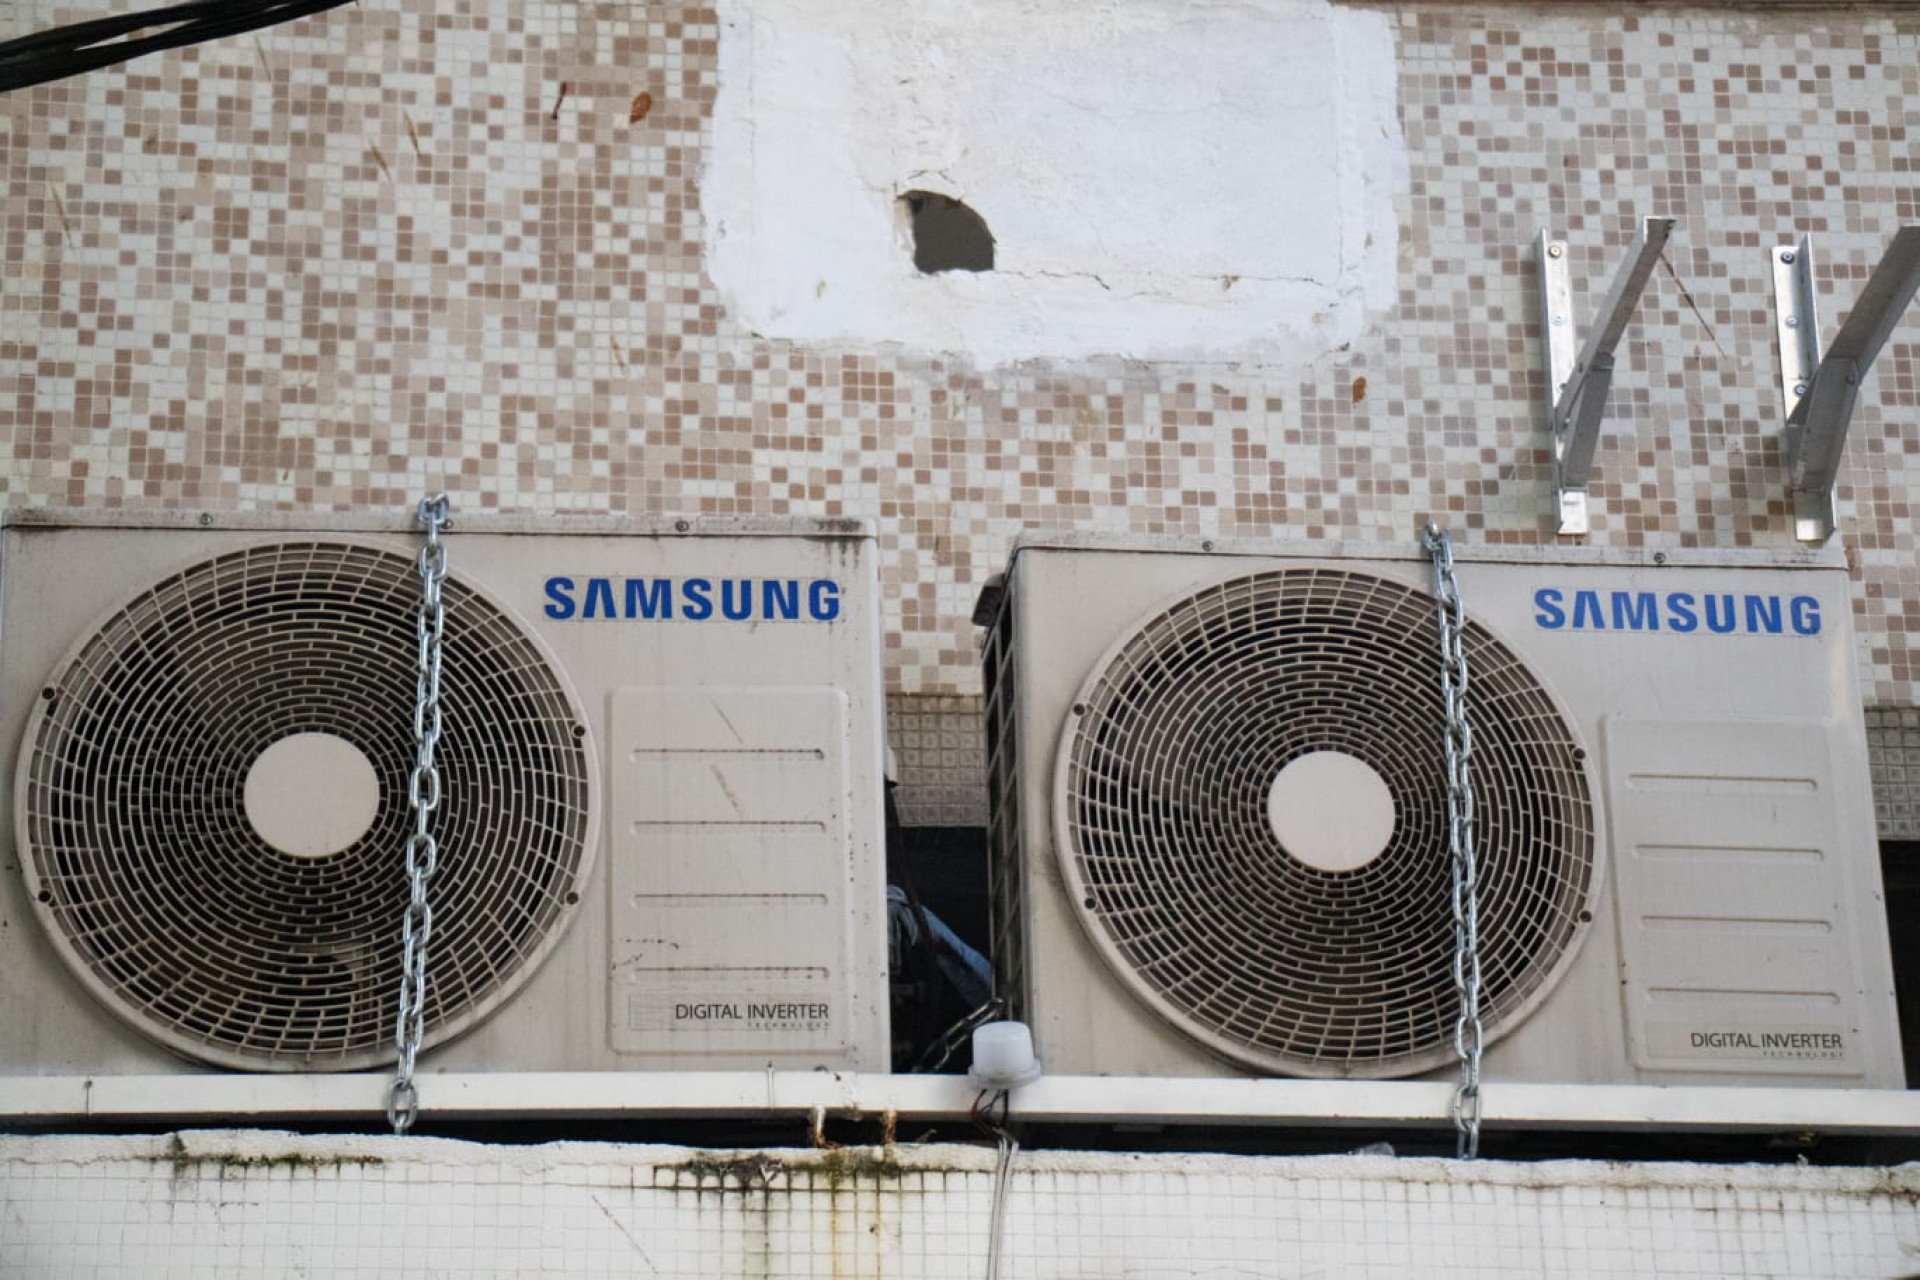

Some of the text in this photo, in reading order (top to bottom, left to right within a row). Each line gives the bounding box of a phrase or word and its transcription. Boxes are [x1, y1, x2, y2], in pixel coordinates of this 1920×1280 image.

[543, 577, 839, 621] SAMSUNG
[1534, 588, 1821, 635] SAMSUNG
[676, 1004, 829, 1020] DIGITAL INVERTER
[1691, 1033, 1843, 1049] DIGITAL INVERTER
